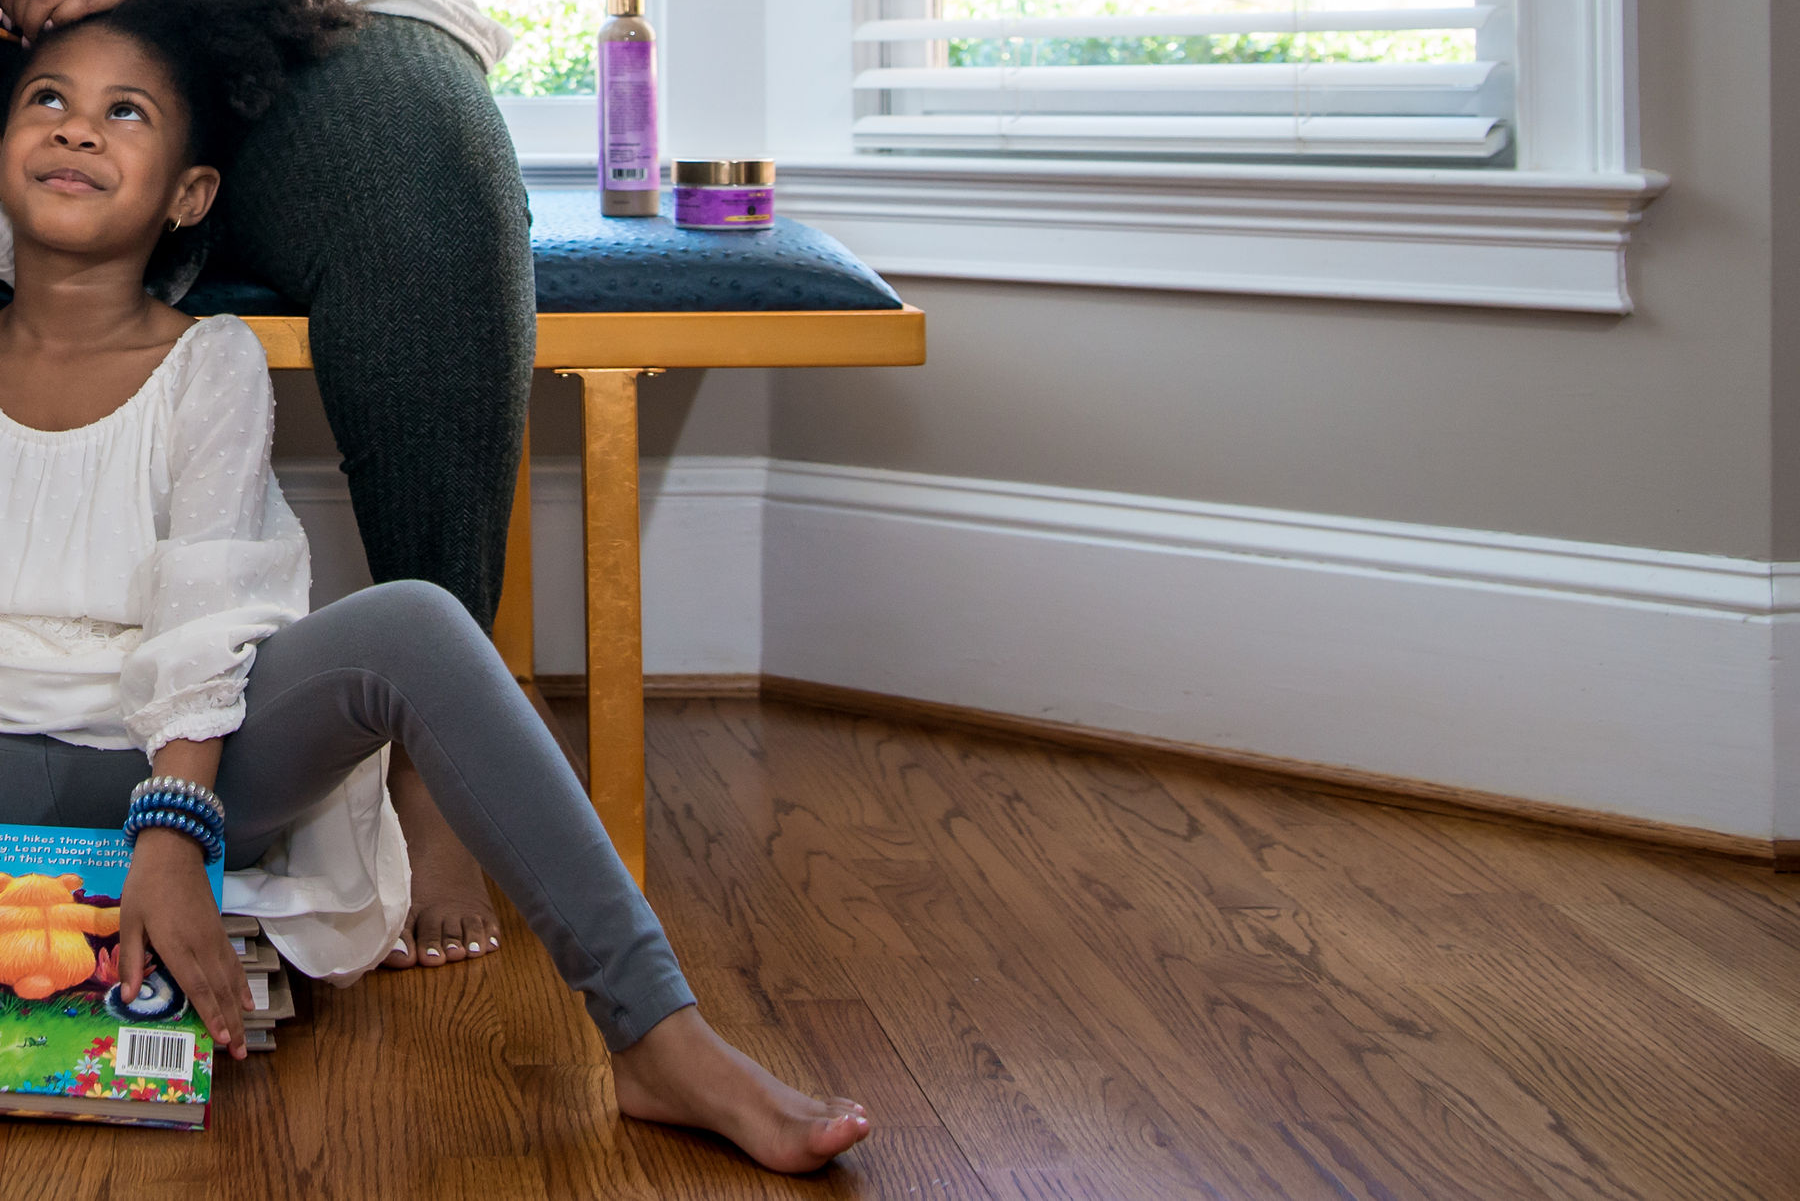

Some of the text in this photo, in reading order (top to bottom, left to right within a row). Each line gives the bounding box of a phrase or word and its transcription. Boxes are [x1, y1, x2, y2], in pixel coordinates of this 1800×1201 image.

[23, 834, 55, 844] hikes
[60, 836, 110, 848] through
[15, 845, 51, 854] Learn
[55, 846, 92, 855] about
[4, 853, 15, 863] in
[19, 855, 44, 864] this
[47, 857, 131, 868] warm-hearte
